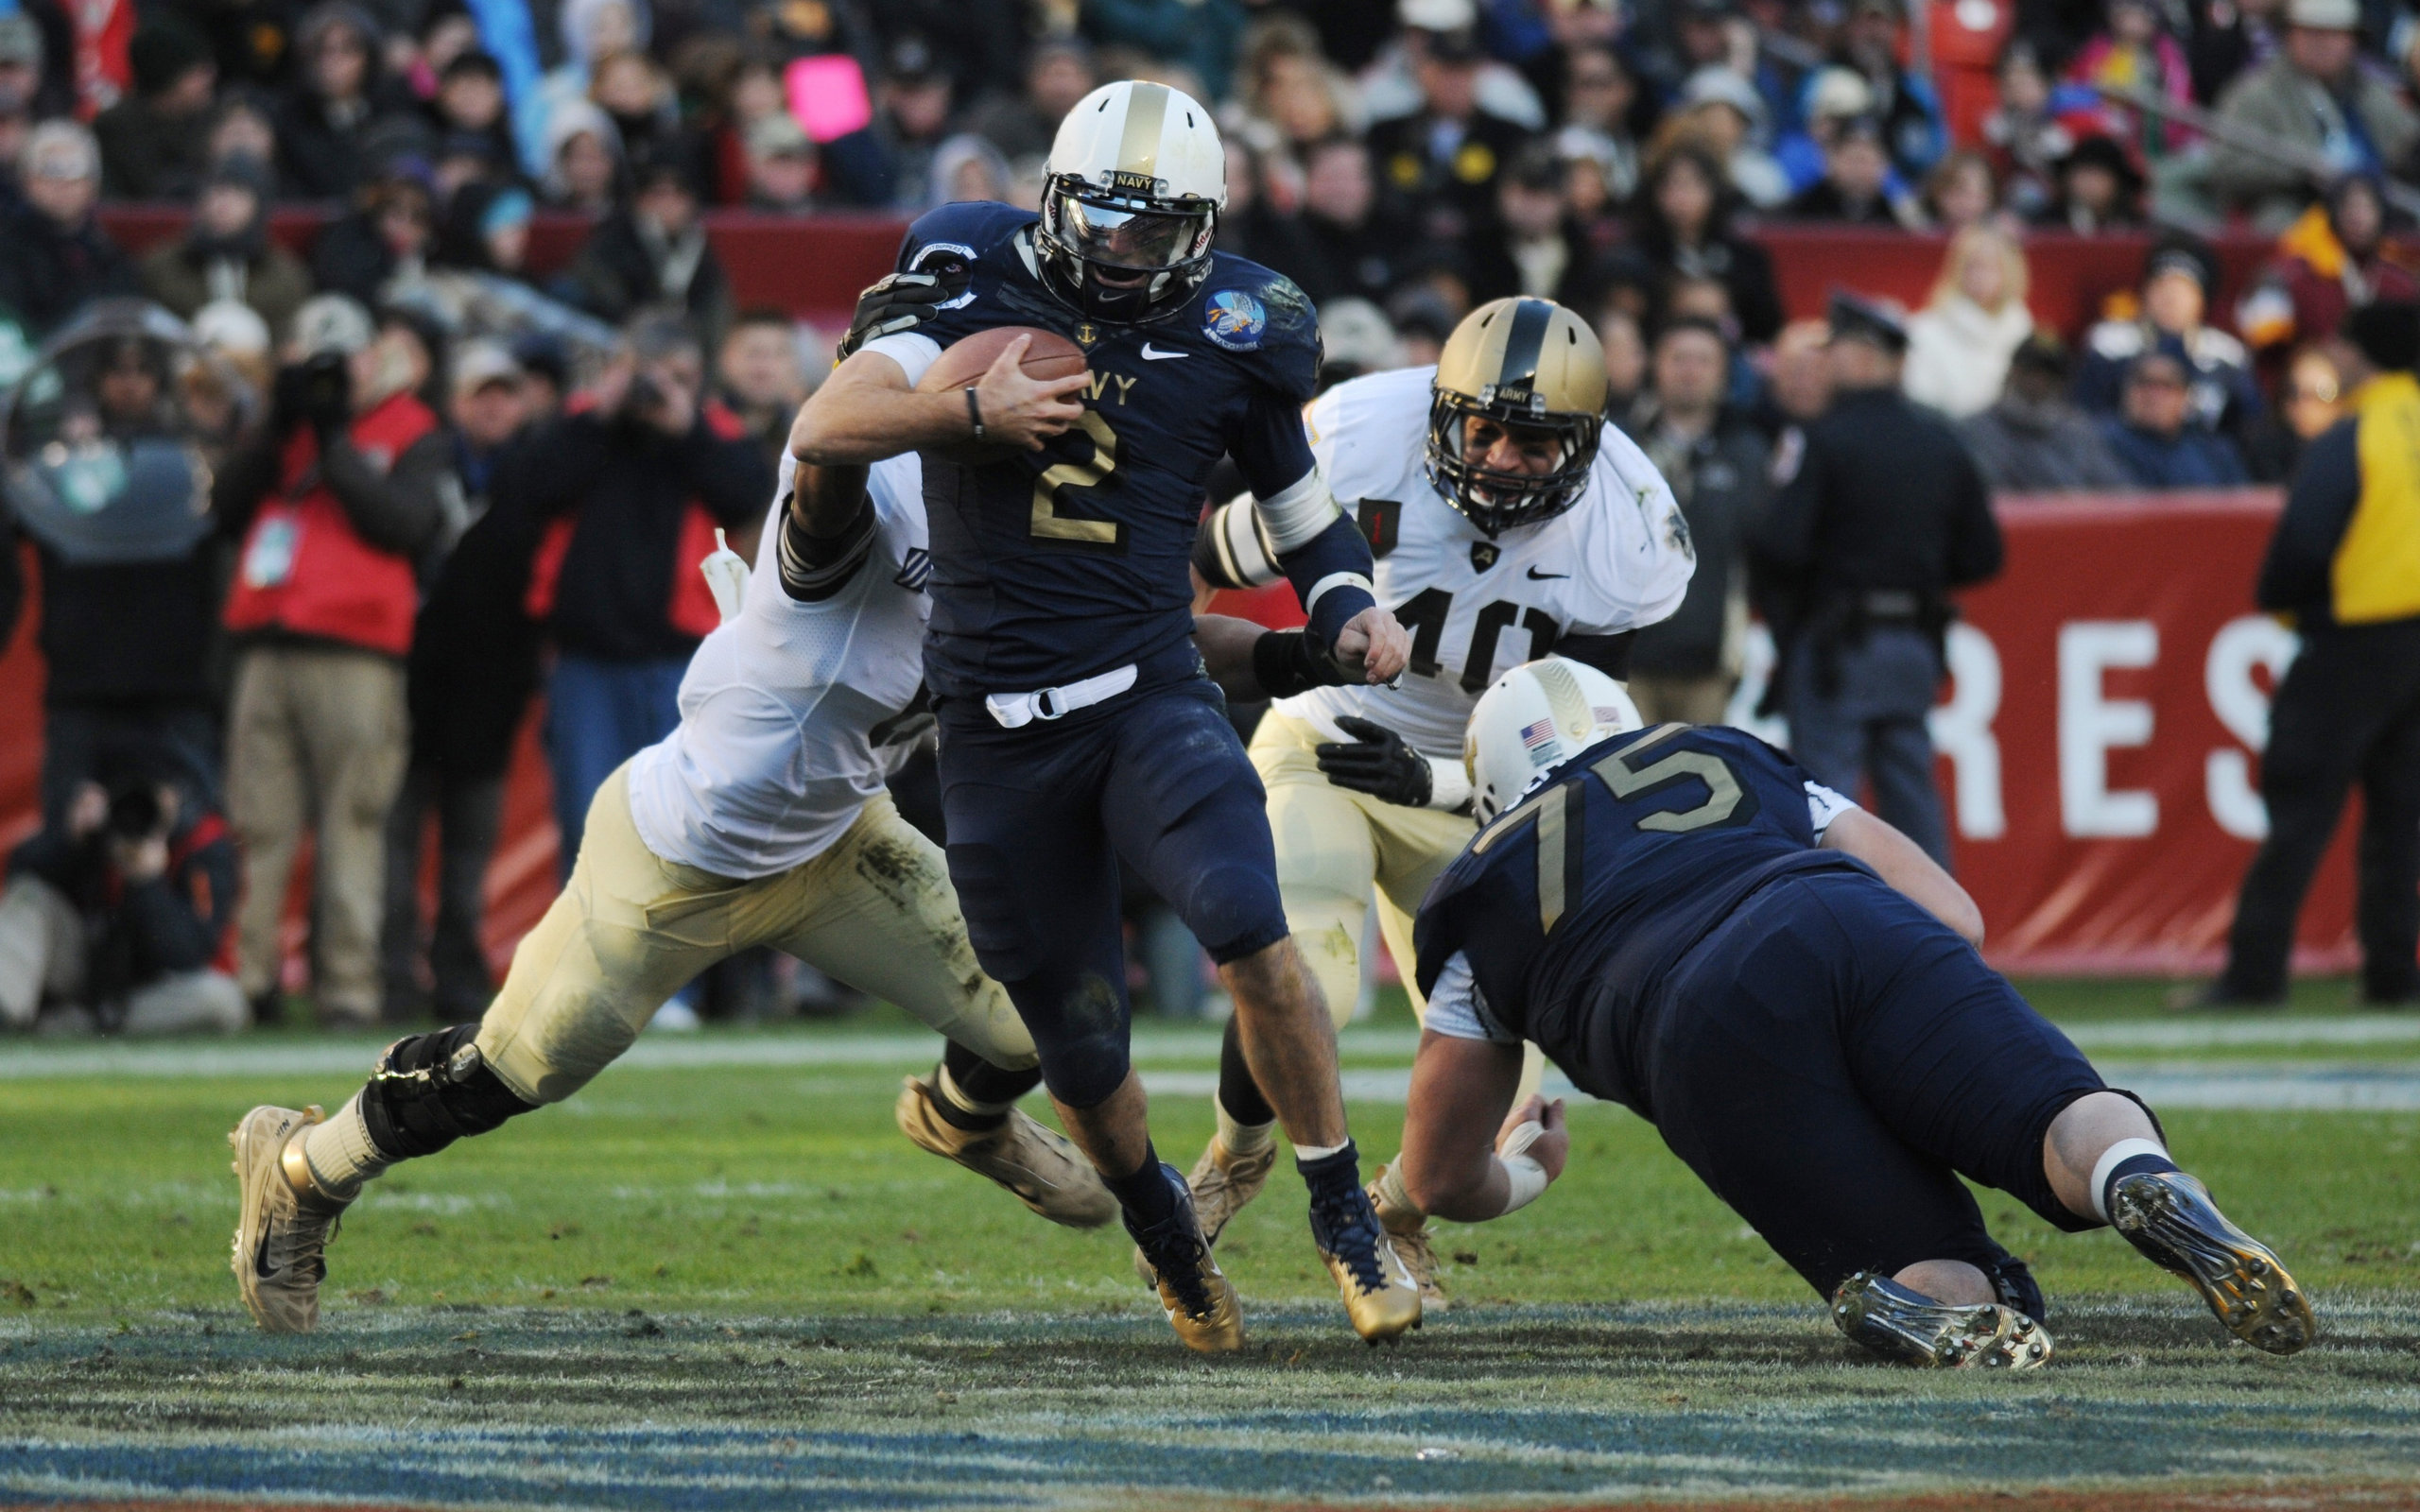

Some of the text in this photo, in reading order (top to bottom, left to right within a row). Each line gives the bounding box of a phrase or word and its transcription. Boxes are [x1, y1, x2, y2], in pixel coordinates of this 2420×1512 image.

[1117, 175, 1152, 190] NAVY
[1080, 369, 1137, 405] VY
[1499, 387, 1530, 404] ARMY
[1030, 409, 1117, 543] 2
[1392, 586, 1560, 696] 10
[1473, 722, 1744, 937] 75
